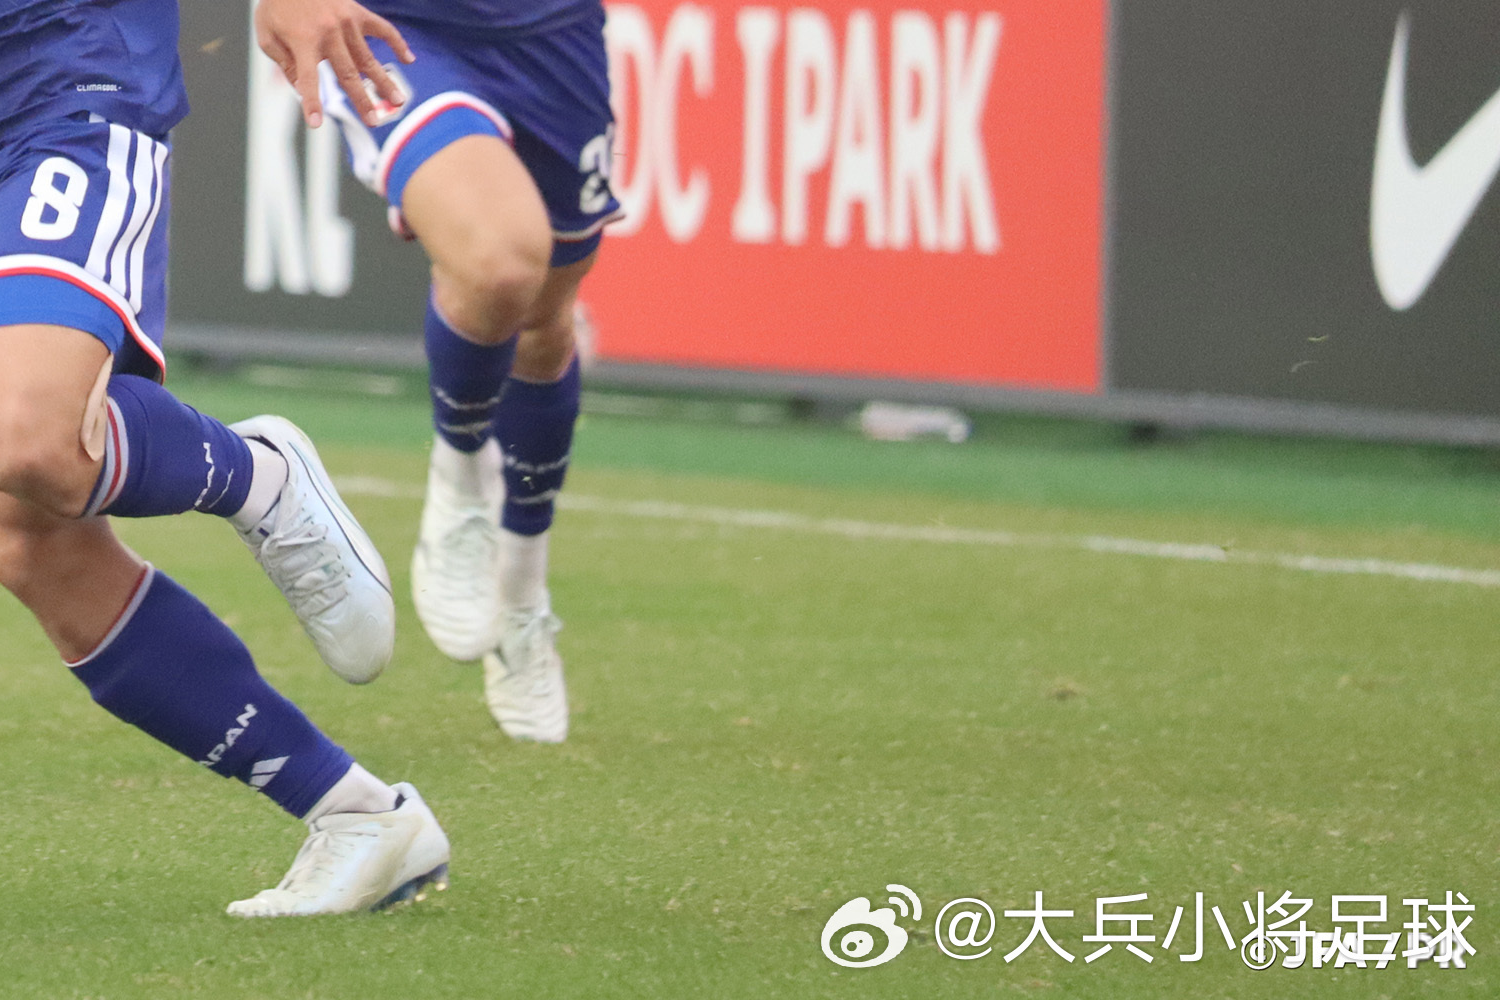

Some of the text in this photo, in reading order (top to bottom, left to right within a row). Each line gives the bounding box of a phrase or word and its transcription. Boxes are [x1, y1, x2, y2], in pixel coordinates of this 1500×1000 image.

[580, 121, 614, 215] 2
[602, 1, 1004, 256] DC IPARK
[20, 156, 89, 241] 8
